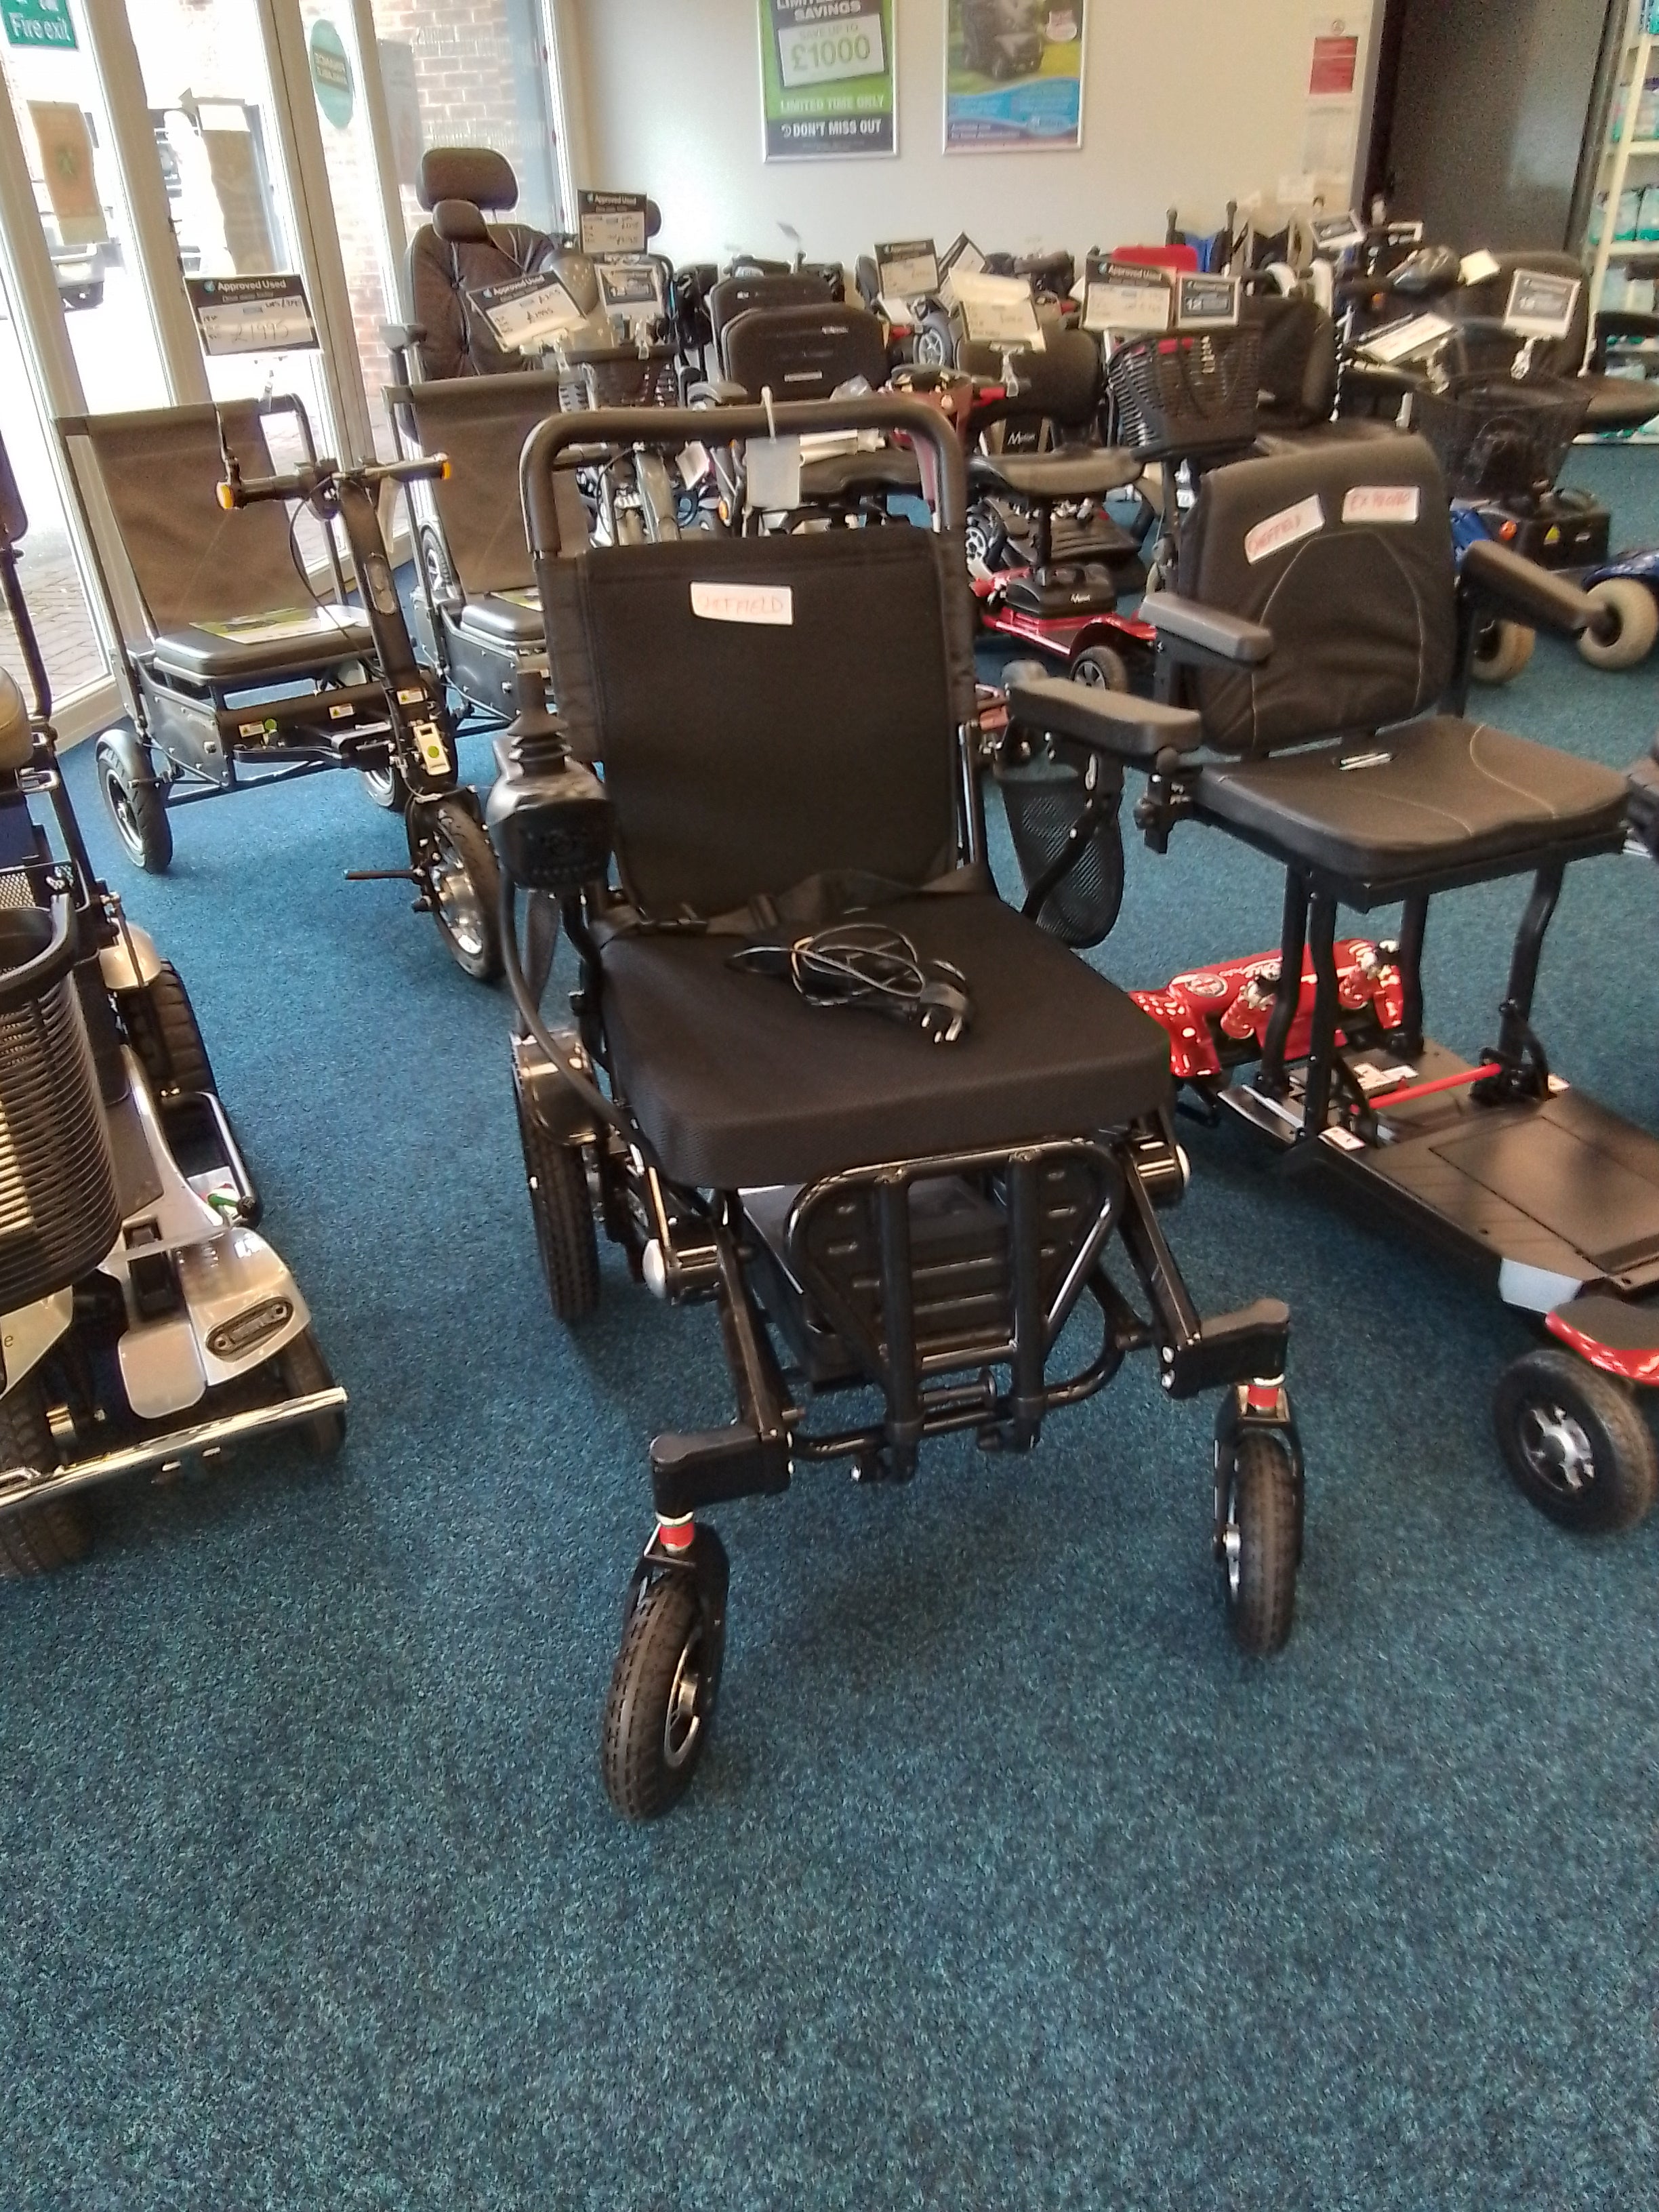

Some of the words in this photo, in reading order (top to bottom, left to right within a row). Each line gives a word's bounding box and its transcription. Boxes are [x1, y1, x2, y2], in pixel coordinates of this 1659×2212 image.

[794, 1, 861, 21] SAVINGS
[8, 12, 43, 39] Fire
[43, 16, 70, 41] exit
[791, 35, 870, 71] £1000
[781, 99, 824, 112] LIMITED
[857, 95, 884, 108] ONLY
[793, 121, 825, 137] DON'T
[828, 119, 857, 136] MISS
[860, 119, 882, 134] OUT
[218, 279, 262, 292] Approved
[263, 279, 287, 289] Used
